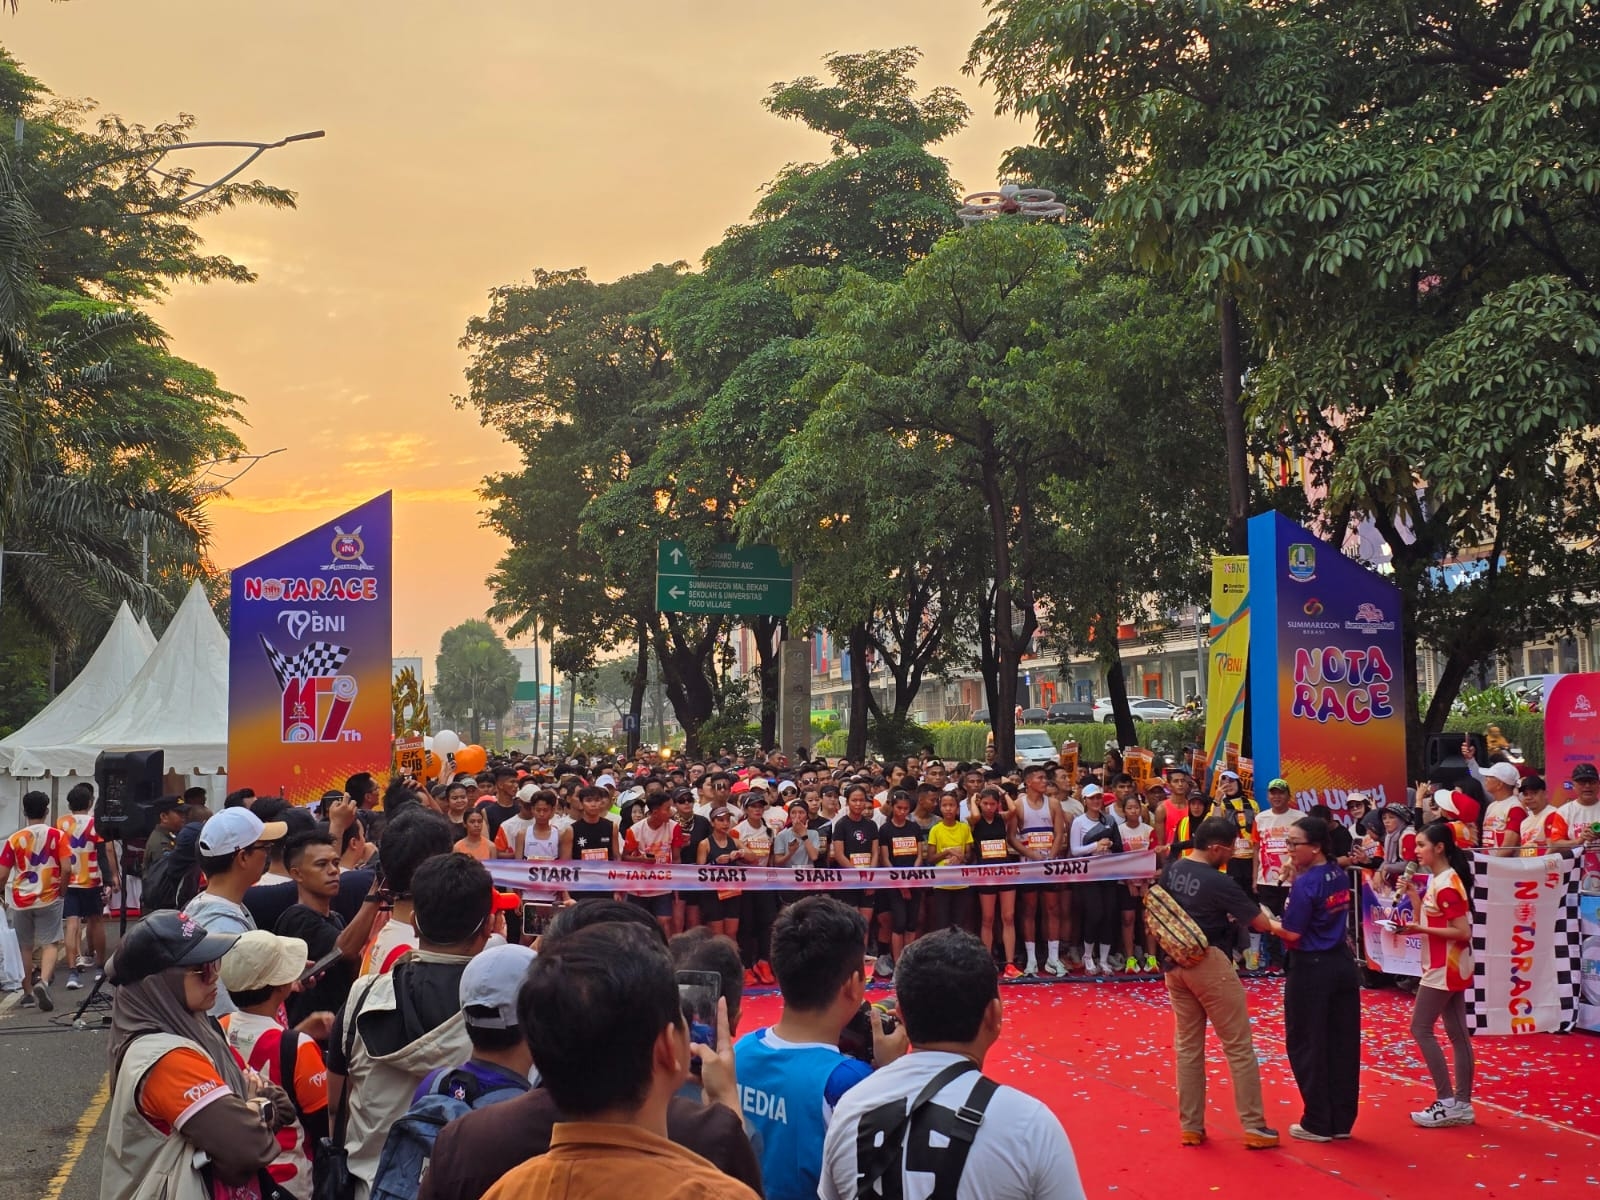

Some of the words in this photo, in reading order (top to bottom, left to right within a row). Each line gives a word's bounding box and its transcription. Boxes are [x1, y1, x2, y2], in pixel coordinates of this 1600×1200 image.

[688, 581, 732, 590] SUMMARECON
[746, 584, 769, 592] BEKASI
[688, 592, 718, 600] SEKOLAH
[723, 593, 763, 601] UNIVERSITAS
[311, 615, 346, 633] BNI
[1287, 621, 1341, 630] SUMMARECON
[1226, 657, 1243, 673] BNI
[1294, 645, 1394, 687] NOTA
[1292, 683, 1393, 725] RACE
[1324, 783, 1387, 811] UNY
[527, 866, 582, 883] START
[697, 867, 748, 883] START
[794, 868, 843, 884] START
[889, 869, 937, 882] START
[1043, 860, 1091, 877] START
[199, 1079, 218, 1093] BNI
